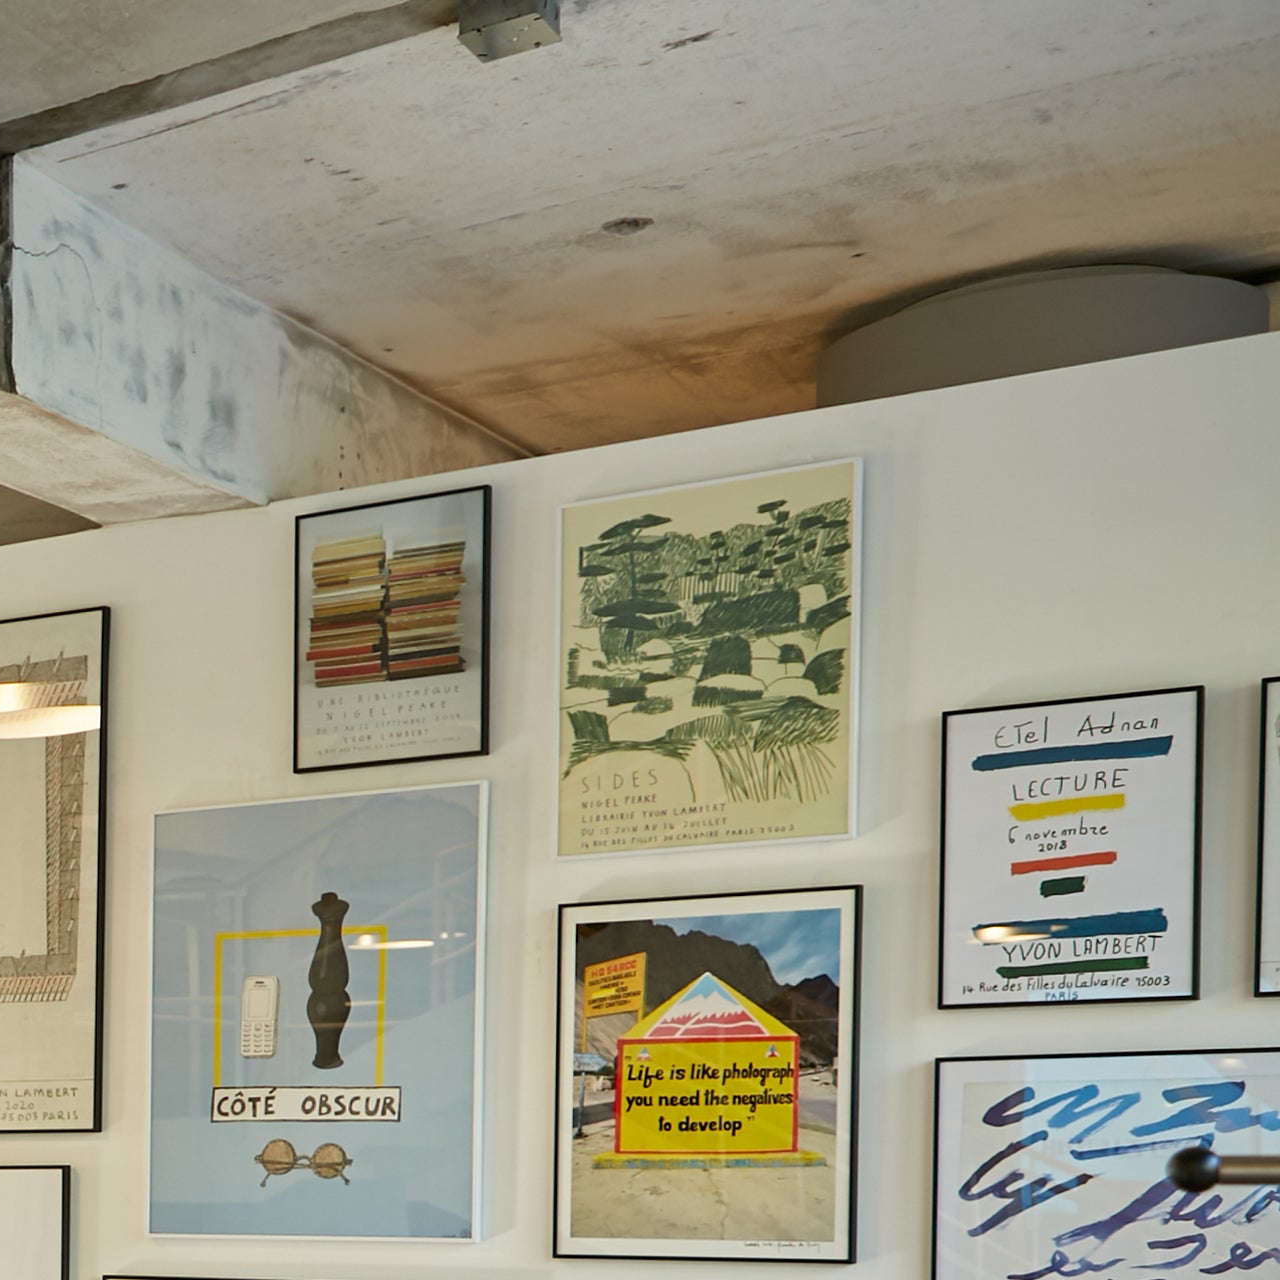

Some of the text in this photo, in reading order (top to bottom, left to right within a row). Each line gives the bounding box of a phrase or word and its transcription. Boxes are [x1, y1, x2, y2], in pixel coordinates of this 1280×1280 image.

[326, 707, 387, 720] NIGEL
[1077, 712, 1159, 738] Adnan
[582, 769, 658, 794] SIDES
[1013, 768, 1128, 801] LECTURE
[581, 793, 656, 809] NIGEL PEAKE
[582, 811, 635, 823] LIBRAIRIE
[673, 803, 726, 816] LAMBERT
[581, 828, 594, 836] DU
[615, 825, 638, 834] JUIN
[645, 824, 658, 832] AU
[683, 817, 727, 829] JUILLET
[677, 830, 719, 841] CALVAIRE
[1008, 817, 1108, 844] 6 novembre
[1002, 935, 1163, 963] YVON LAMBERT
[962, 986, 974, 995] 14
[979, 982, 999, 992] Rue
[1002, 978, 1022, 992] des
[1027, 977, 1055, 991] Filles
[1059, 974, 1073, 990] du
[1045, 991, 1079, 1001] PARIS
[669, 1065, 686, 1080] is
[690, 1063, 720, 1080] like
[722, 1062, 794, 1087] photograph
[14, 1087, 79, 1098] LAMBERT
[216, 1087, 397, 1118] CÔTÉ OBSCUR
[626, 1088, 794, 1113] you need the negatives
[0, 1112, 38, 1122] 75003
[42, 1110, 79, 1120] PARIS
[6, 1101, 35, 1111] 2020
[658, 1116, 672, 1131] to
